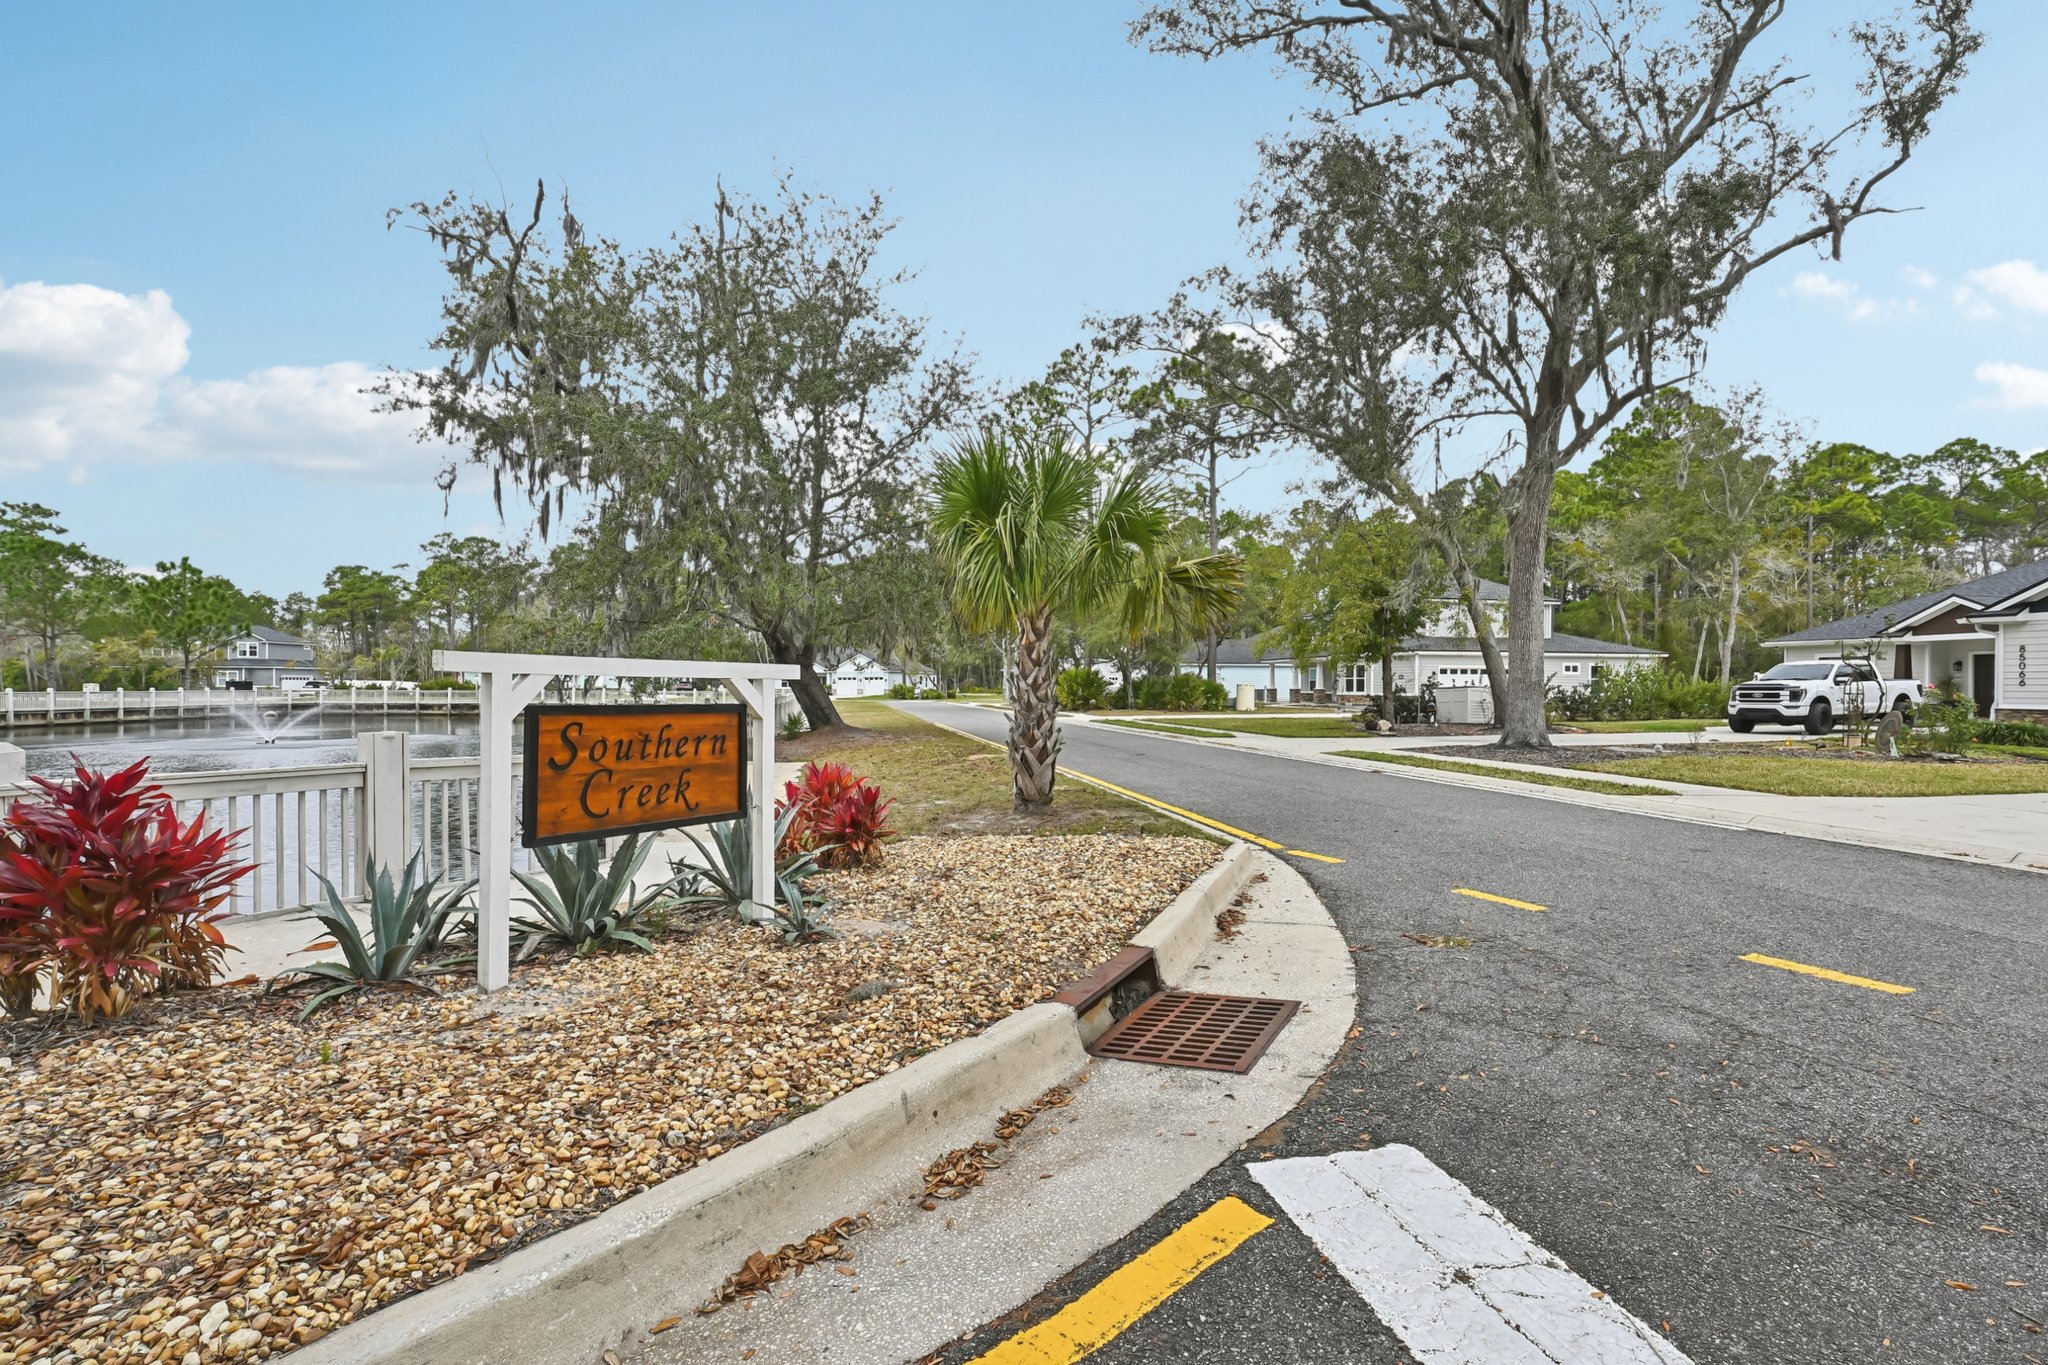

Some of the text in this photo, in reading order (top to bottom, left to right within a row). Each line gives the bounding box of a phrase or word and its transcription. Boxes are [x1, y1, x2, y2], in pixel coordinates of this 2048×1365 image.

[2018, 645, 2027, 687] 85066
[548, 722, 727, 771] Southern
[580, 768, 699, 818] Creek
